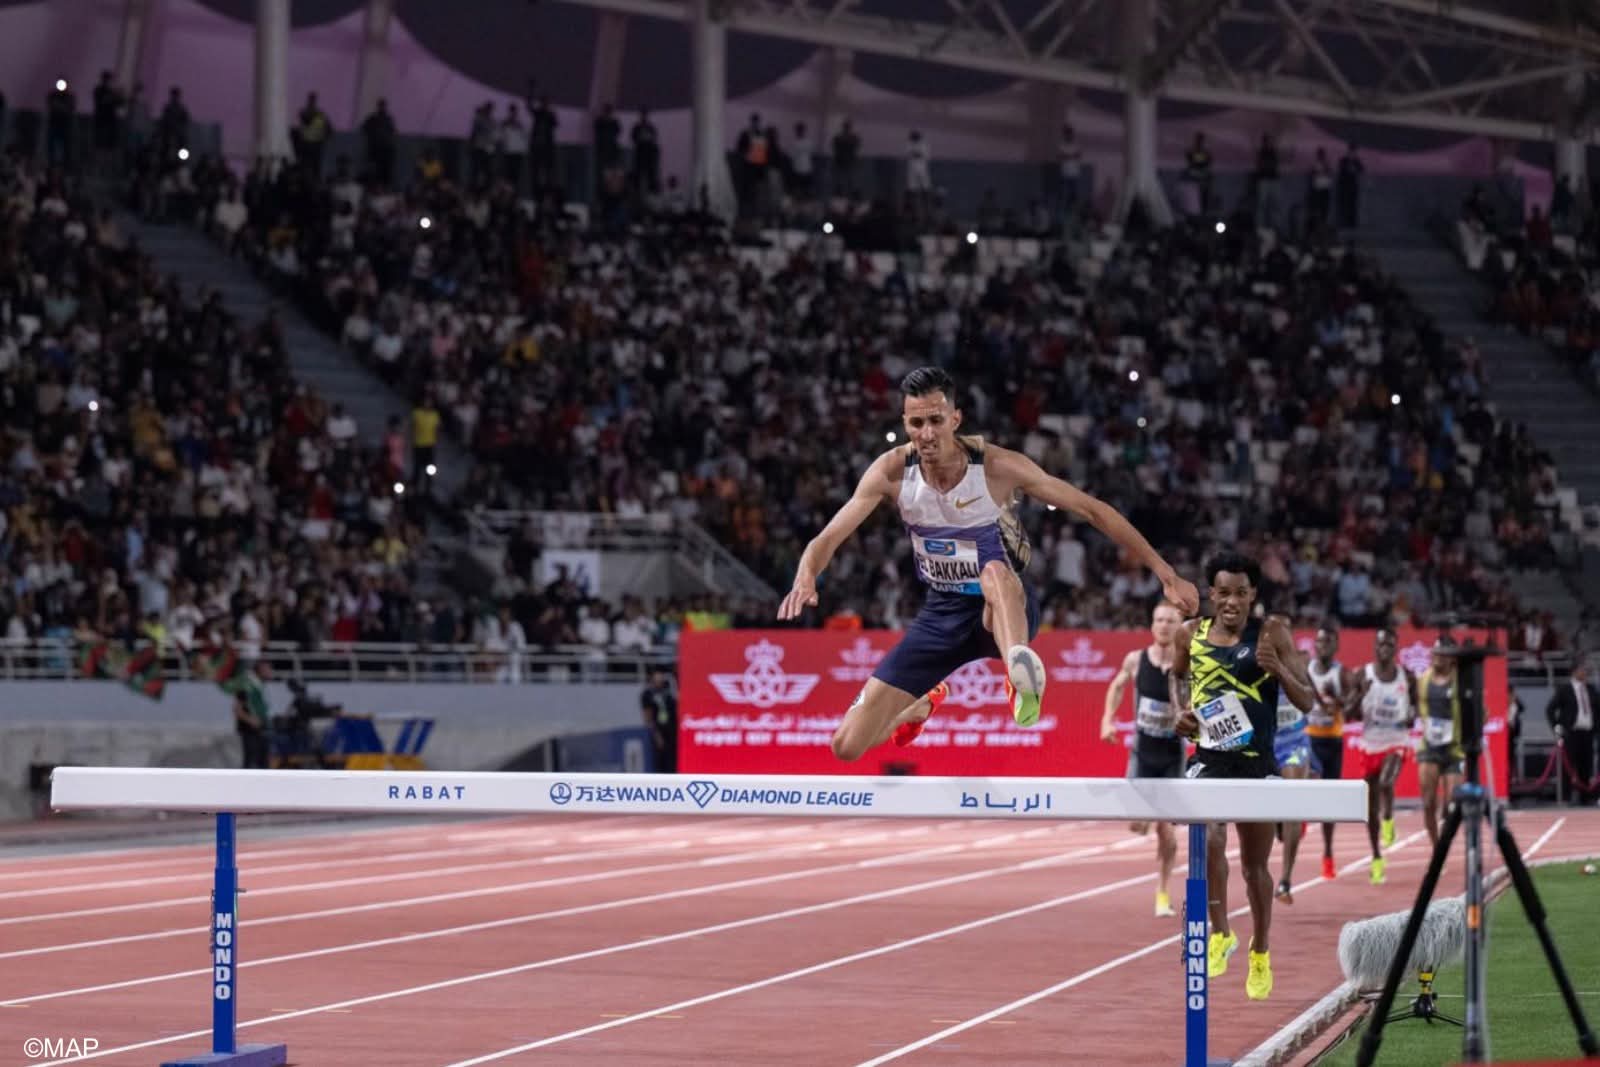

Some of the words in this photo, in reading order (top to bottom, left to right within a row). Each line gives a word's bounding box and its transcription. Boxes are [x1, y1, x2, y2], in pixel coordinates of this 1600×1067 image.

[929, 559, 981, 580] BAKKALI
[1207, 714, 1242, 742] AMARE
[388, 785, 465, 800] RABAT
[616, 787, 685, 802] WANDA
[720, 788, 801, 805] DIAMOND
[806, 791, 874, 807] LEAGUE
[960, 792, 1051, 812] الرباط
[215, 912, 232, 1000] MONDO
[1188, 920, 1205, 1010] MONDO
